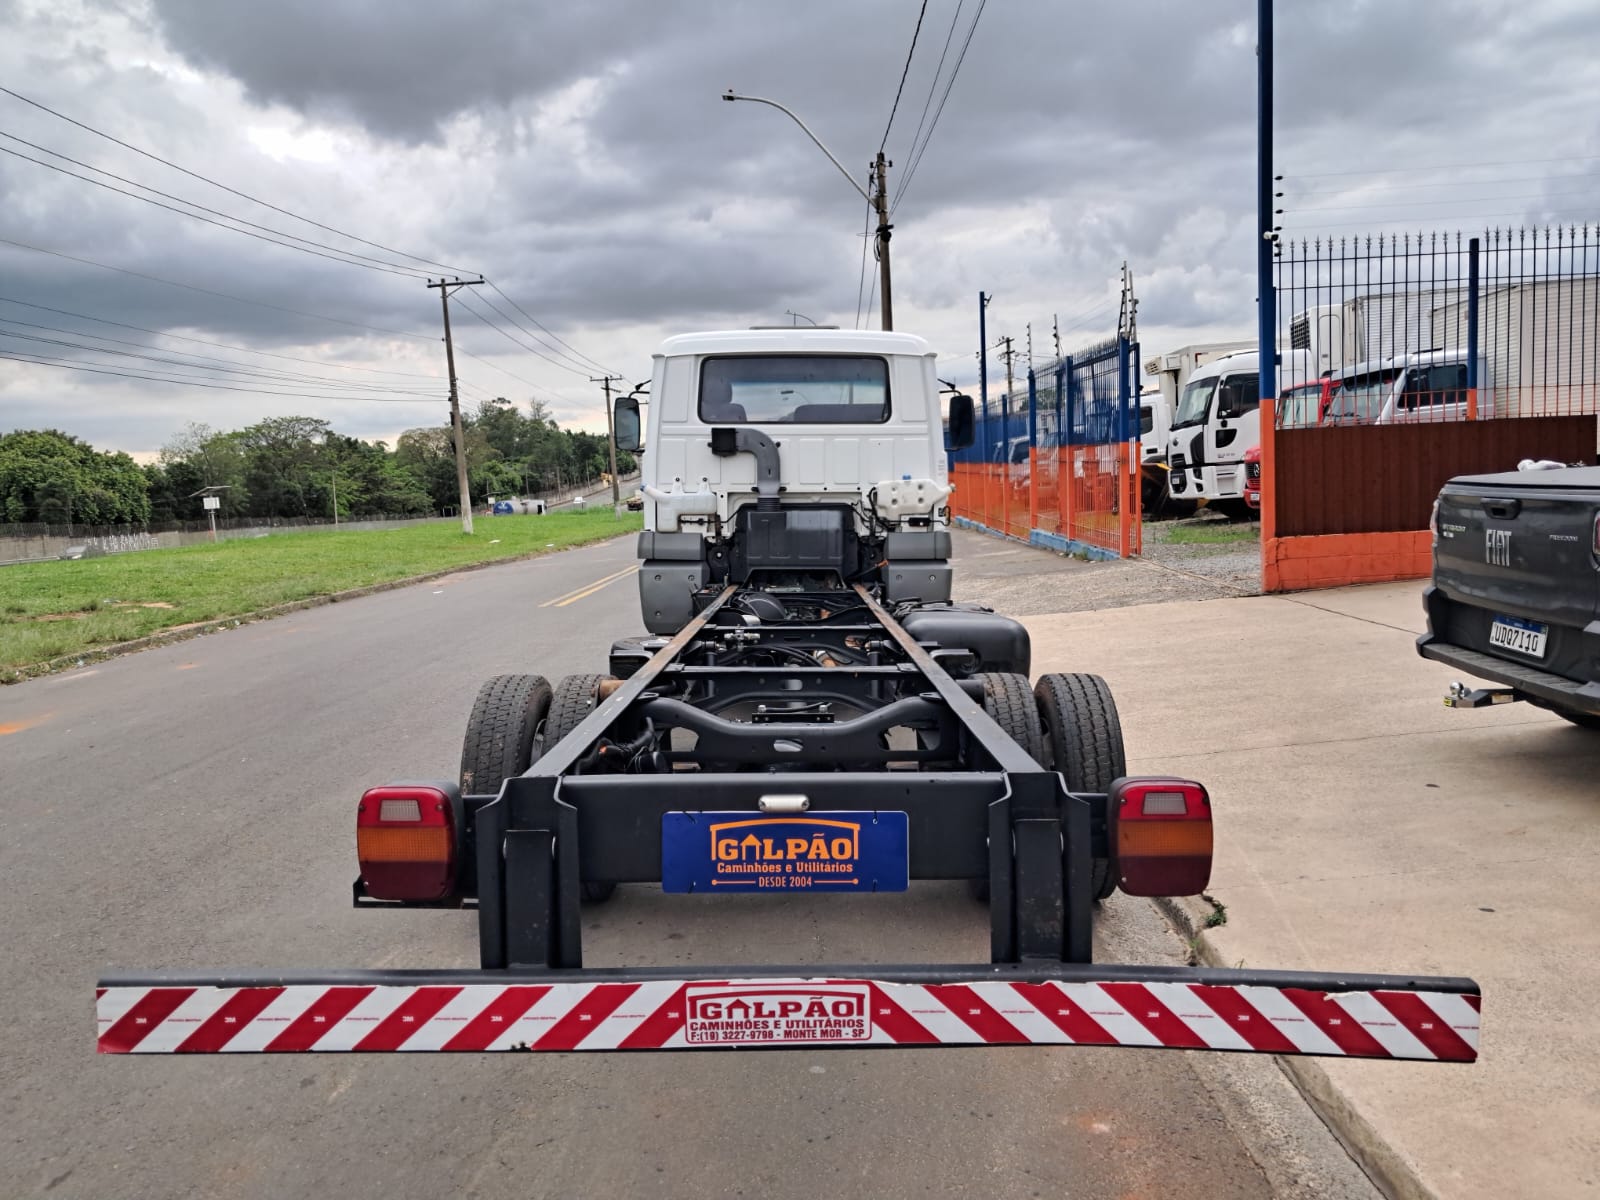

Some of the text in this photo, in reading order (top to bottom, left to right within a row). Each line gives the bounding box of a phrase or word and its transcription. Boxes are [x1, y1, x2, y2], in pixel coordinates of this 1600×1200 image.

[1486, 529, 1512, 567] FIAT
[717, 833, 852, 861] GALPÃO
[717, 861, 853, 873] Caminhões e Utilitários
[759, 877, 812, 888] DESDE 2004
[699, 996, 854, 1020] GALPÃO
[690, 1018, 864, 1031] CAMINHÕES E UTILITÁRIOS
[722, 1030, 774, 1040] 3227-9798
[783, 1029, 817, 1039] MONTE
[820, 1029, 842, 1038] MOR
[852, 1029, 865, 1038] SP
